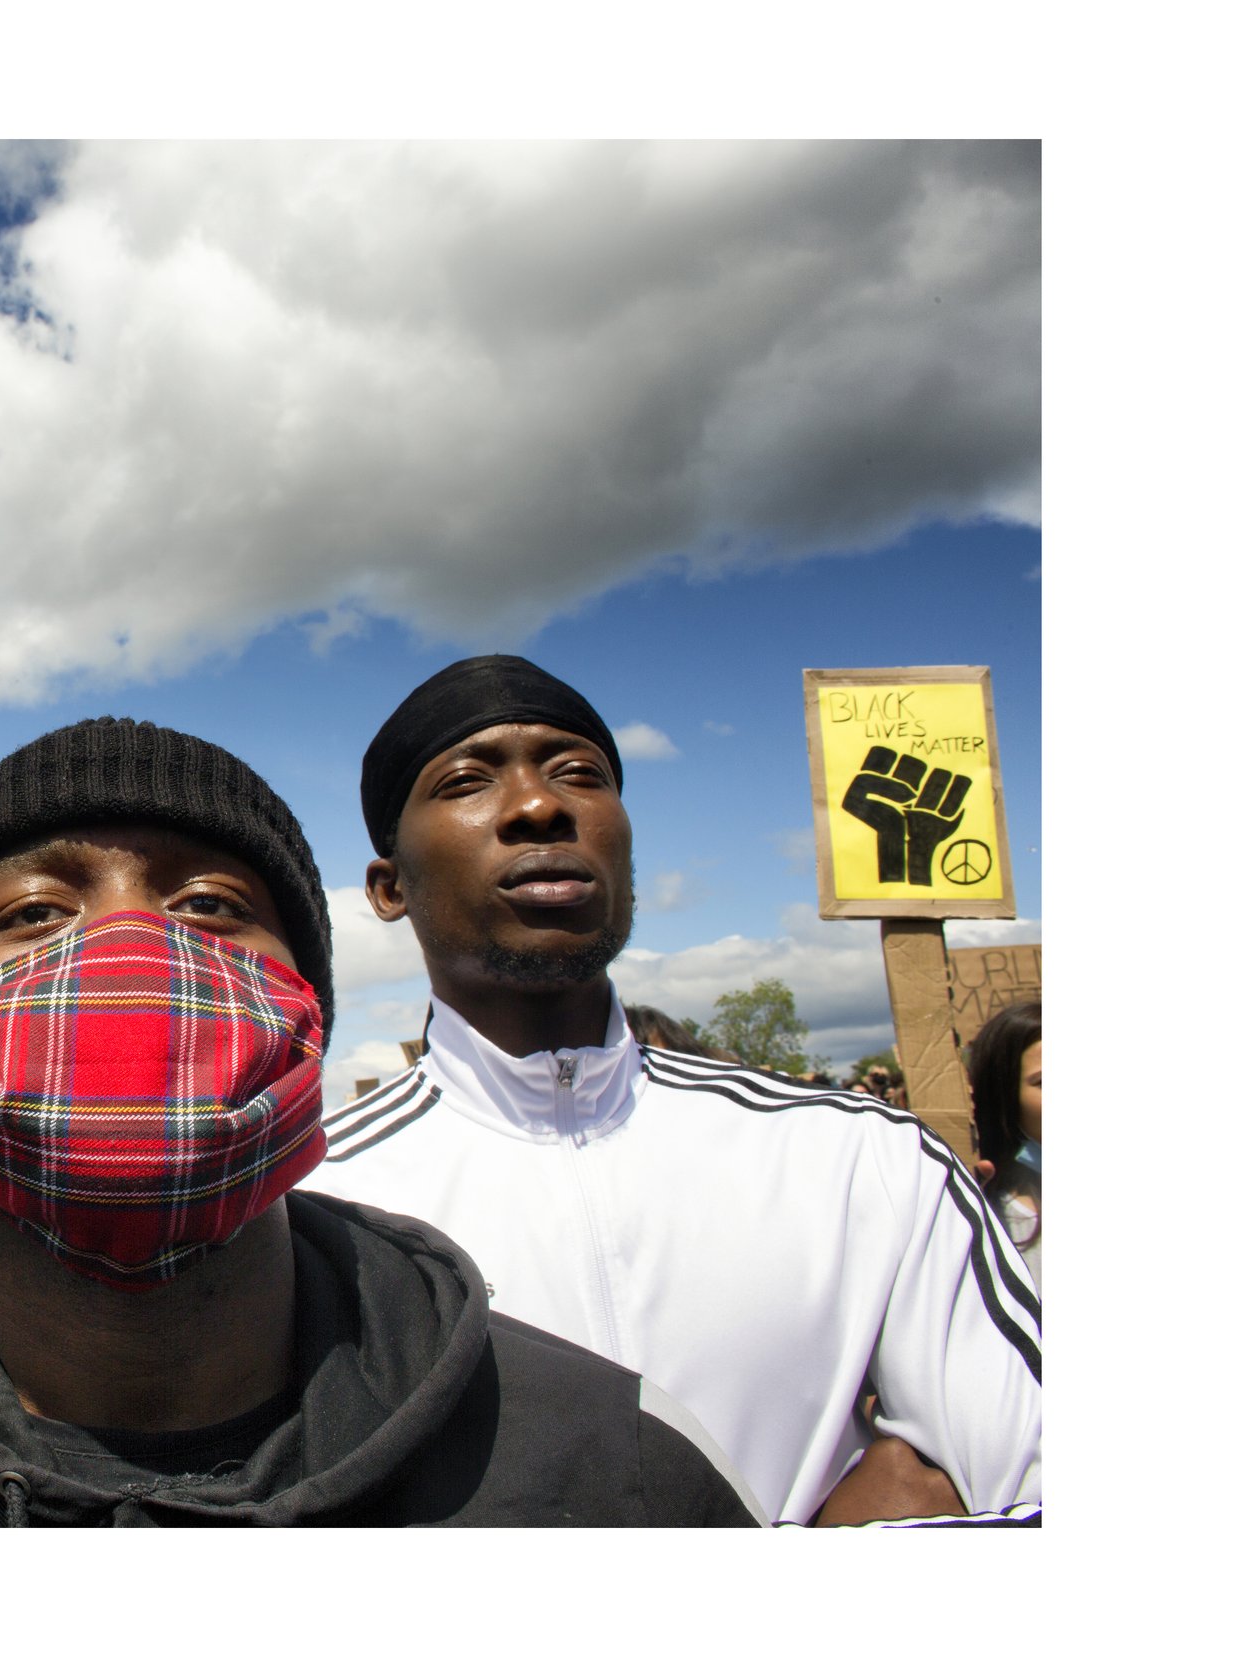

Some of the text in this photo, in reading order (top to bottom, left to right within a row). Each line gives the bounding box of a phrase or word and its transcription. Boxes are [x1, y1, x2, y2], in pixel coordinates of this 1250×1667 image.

[829, 691, 915, 723] BLACK
[865, 719, 927, 739] LIVES
[911, 736, 986, 755] MATTER
